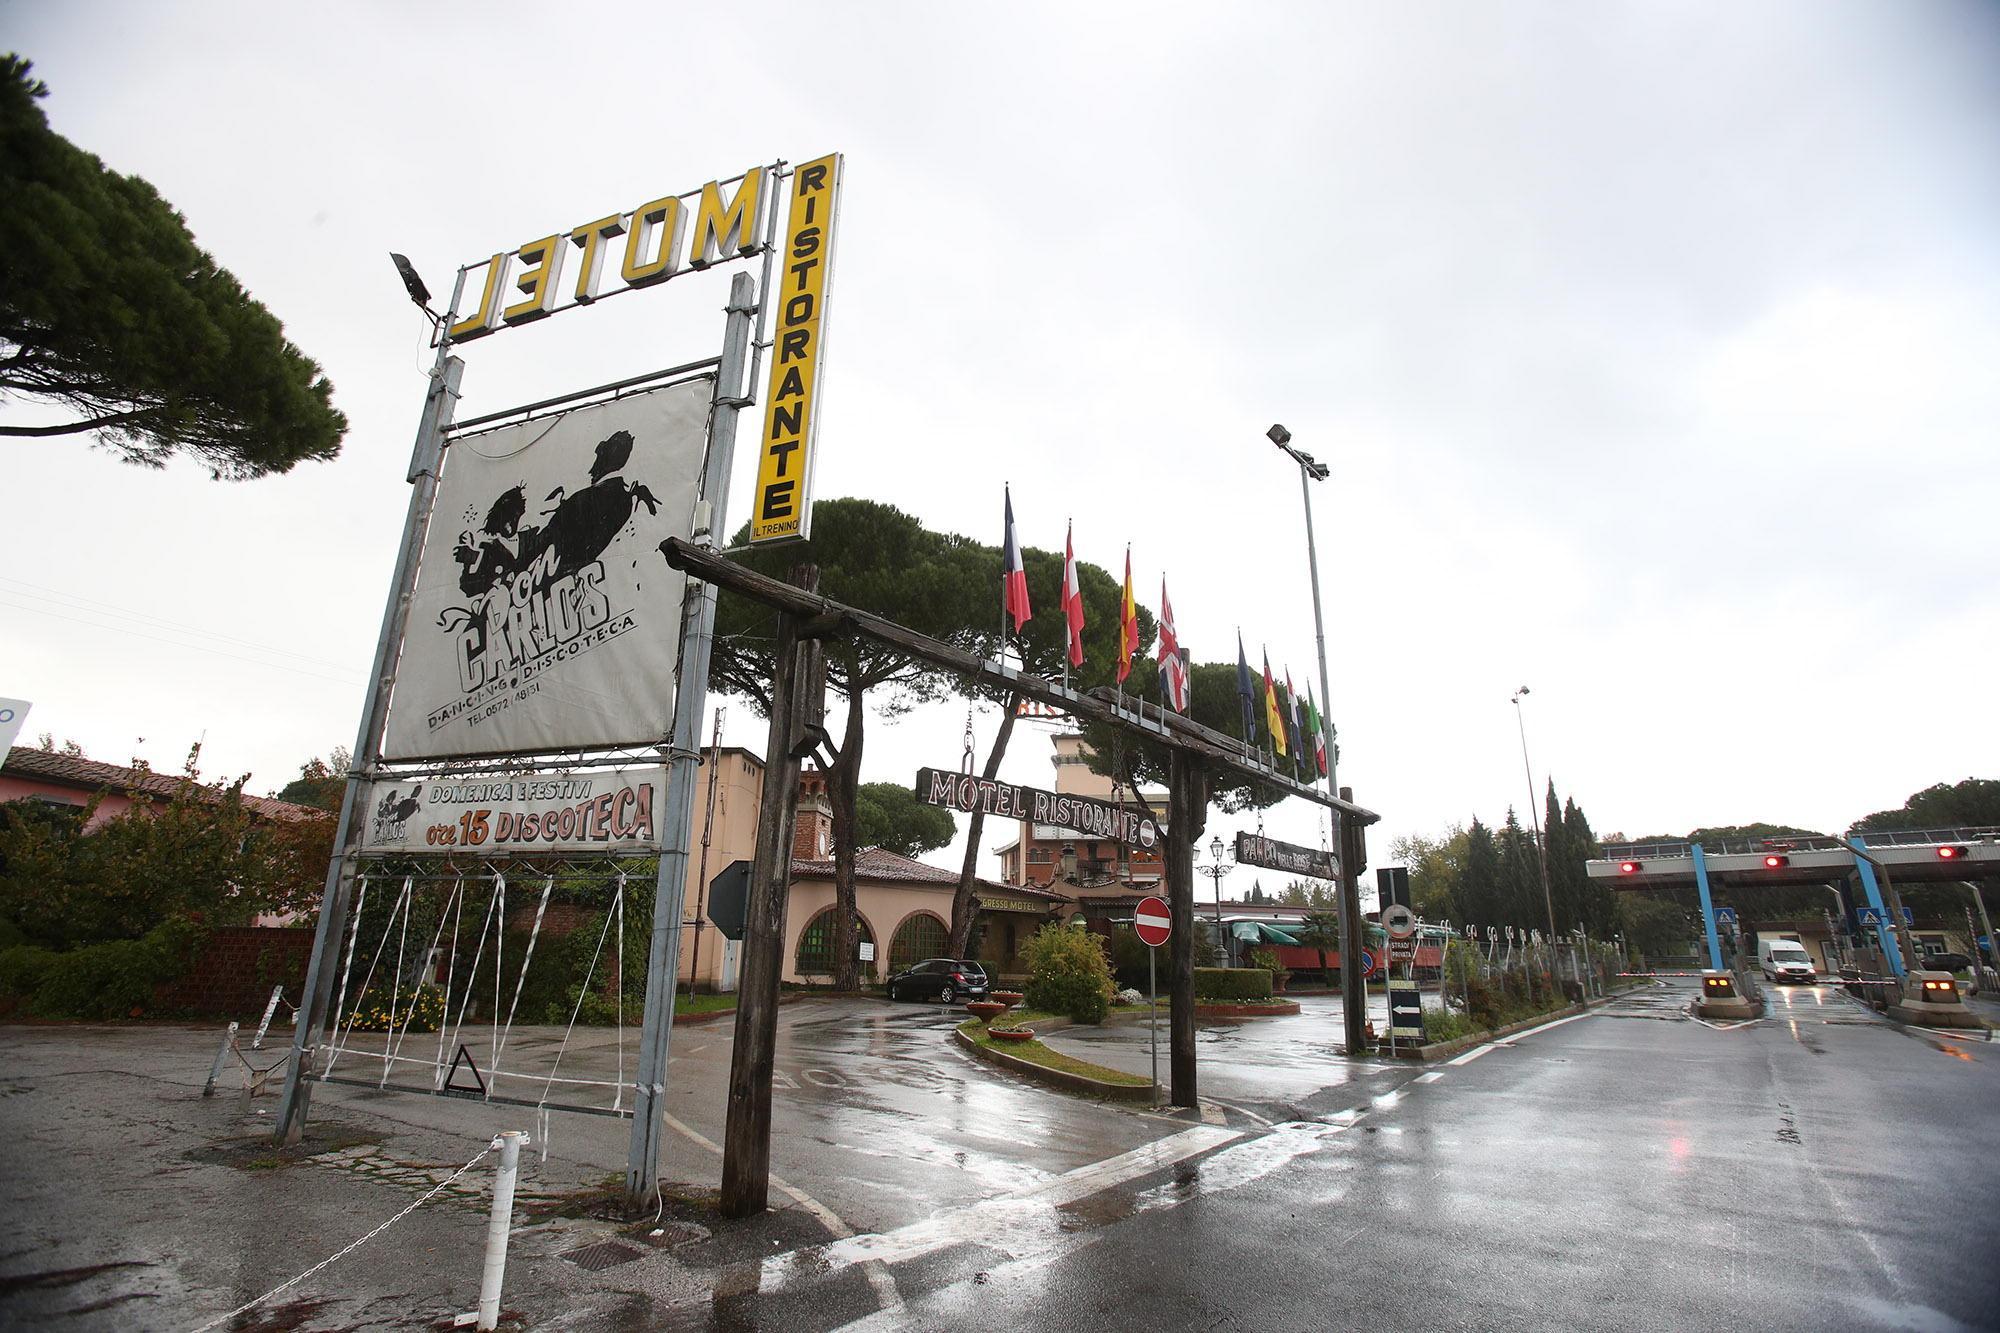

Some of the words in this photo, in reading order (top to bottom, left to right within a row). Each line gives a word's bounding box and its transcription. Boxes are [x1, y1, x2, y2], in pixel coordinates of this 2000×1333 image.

[762, 164, 828, 520] RISTORANTE
[753, 527, 761, 537] IL
[762, 520, 799, 535] TRENINO
[430, 783, 513, 804] DOMENICA
[527, 780, 593, 800] FESTIVI
[928, 771, 1027, 818] MOTEL
[1034, 791, 1139, 844] RISTORANTE
[425, 823, 458, 846] ore
[459, 809, 492, 846] 15
[494, 783, 655, 843] DISCOTECA
[981, 898, 1008, 909] GRESSO
[1010, 901, 1036, 911] MOTEL
